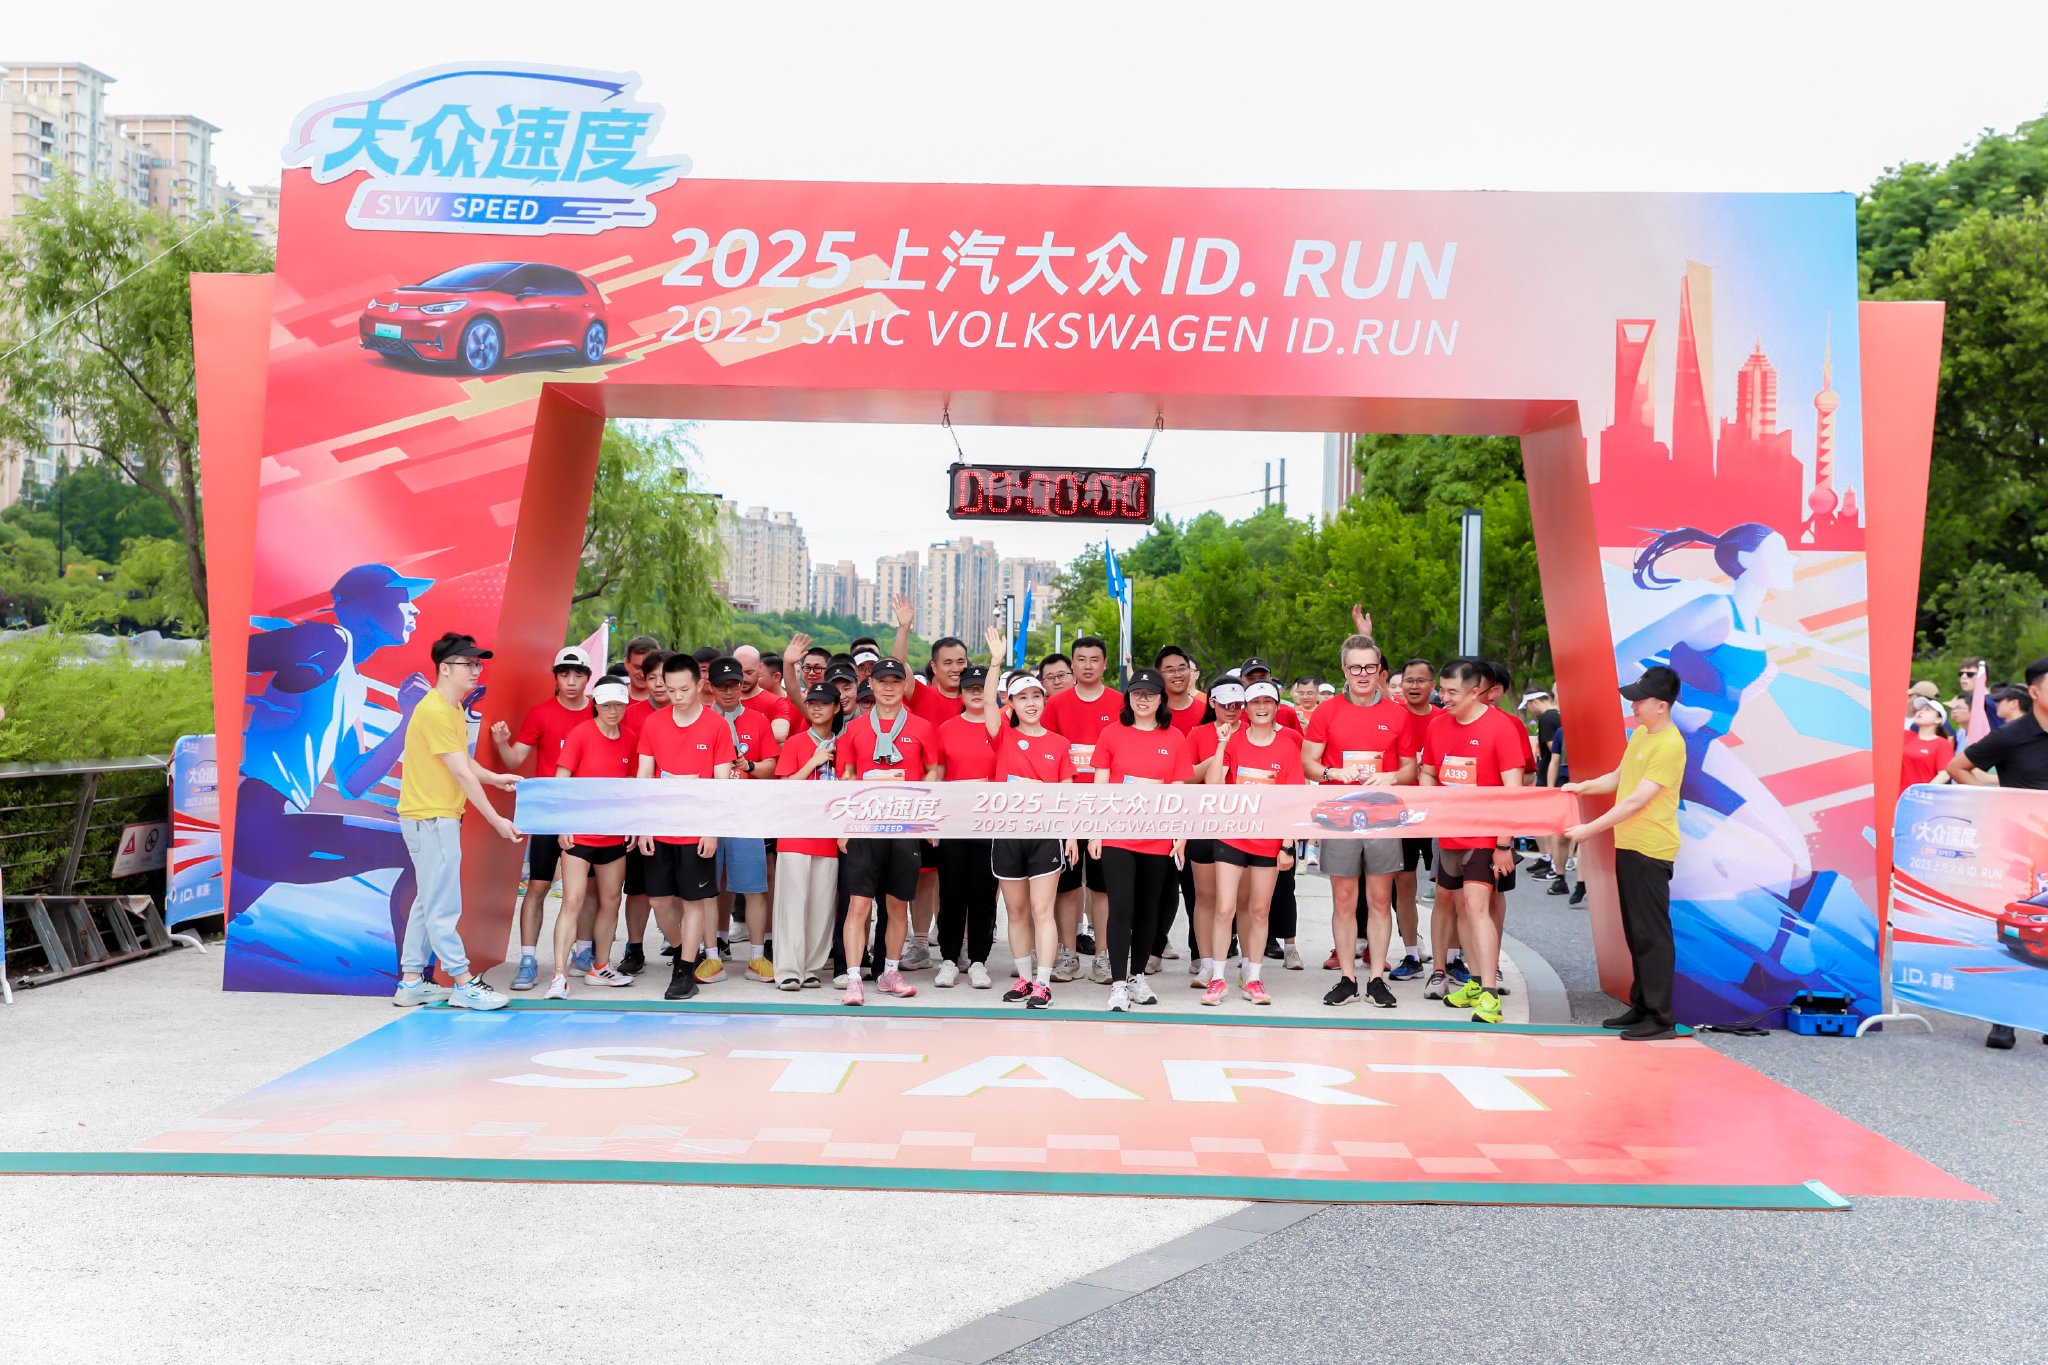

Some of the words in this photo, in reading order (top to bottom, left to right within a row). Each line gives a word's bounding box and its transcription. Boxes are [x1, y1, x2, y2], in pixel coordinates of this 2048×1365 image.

[322, 101, 685, 187] 大众速度
[375, 194, 441, 217] SVW
[450, 197, 539, 221] SPEED
[1283, 239, 1458, 300] RUN
[660, 305, 785, 345] 2025
[801, 308, 911, 346] SAIC
[927, 310, 1269, 354] VOLKSWAGEN
[1286, 316, 1460, 357] ID.RUN
[959, 471, 1145, 517] 00:00:00
[1444, 768, 1468, 780] A339
[831, 796, 951, 823] 大众速度
[1200, 793, 1262, 815] RUN
[873, 825, 903, 833] SPEED
[973, 819, 1018, 833] 2025
[1024, 820, 1065, 833] SAIC
[1070, 820, 1195, 833] VOLKSWAGEN
[1201, 820, 1264, 833] ID.RUN
[488, 1046, 1575, 1111] START
